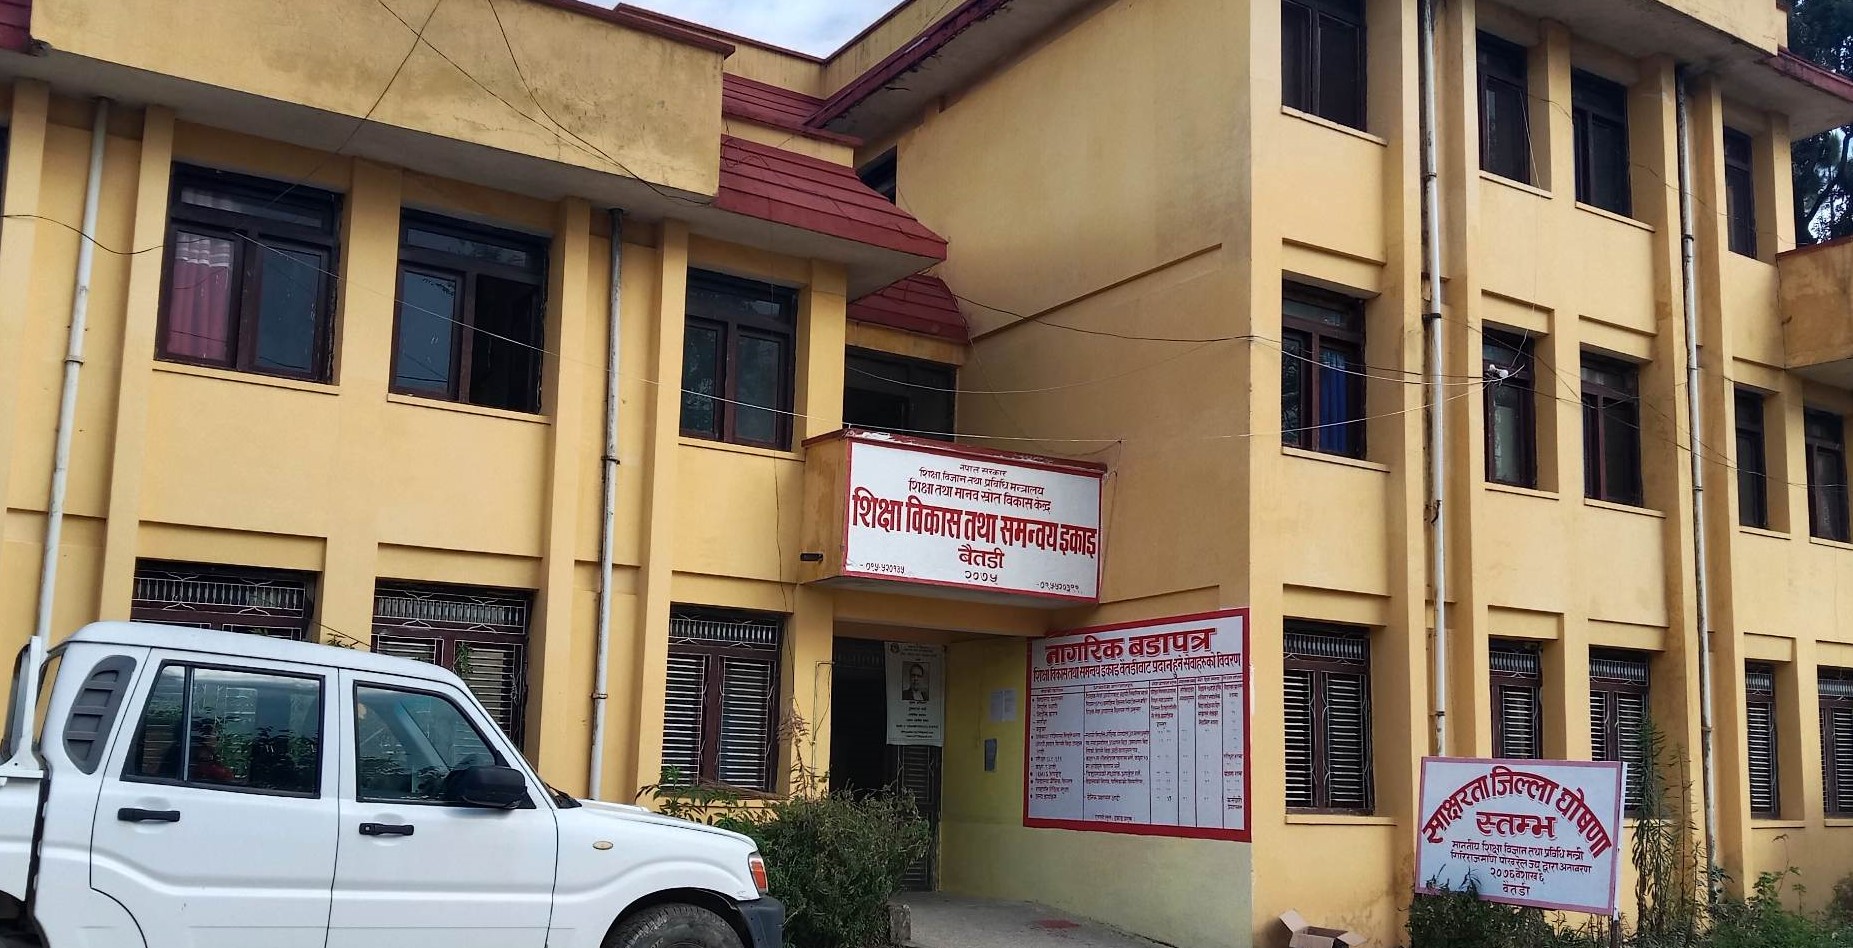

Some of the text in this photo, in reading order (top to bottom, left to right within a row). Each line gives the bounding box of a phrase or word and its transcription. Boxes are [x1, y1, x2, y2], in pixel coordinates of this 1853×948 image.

[919, 467, 941, 480] शिक्षा
[968, 477, 982, 486] तथा
[983, 478, 1009, 492] प्रविधि
[1010, 482, 1044, 496] मन्त्रालय
[981, 467, 1007, 476] सरकार
[908, 478, 934, 494] शिक्षा
[935, 484, 953, 497] तथा
[955, 487, 979, 501] मानव
[1003, 493, 1033, 510] विकास
[1034, 496, 1051, 514] केन्द्र
[852, 487, 904, 533] शिक्षा
[905, 495, 962, 540] विकास
[964, 507, 999, 544] तथा
[1000, 514, 1058, 552] समन्वय
[958, 545, 1004, 569] बैतडी
[964, 570, 998, 585] २०७५
[1045, 628, 1216, 665] नागरिक बडापत्र
[1033, 667, 1049, 683] शिक्षा
[1050, 665, 1068, 681] विकास
[1068, 668, 1079, 679] तथा
[1079, 665, 1101, 679] समन्वय
[1152, 659, 1172, 673] प्रदान
[1217, 652, 1241, 668] विवरण
[1422, 766, 1612, 858] साक्षरता जिल्ला घोषणा
[1476, 812, 1556, 838] स्तम्भ
[1482, 840, 1502, 855] शिक्षा
[1504, 843, 1527, 857] विज्ञान
[1529, 847, 1543, 857] तथा
[1544, 846, 1565, 858] प्रविधि
[1567, 846, 1584, 860] मन्त्री
[1542, 861, 1559, 874] द्वारा
[1560, 863, 1592, 874] अनावरण
